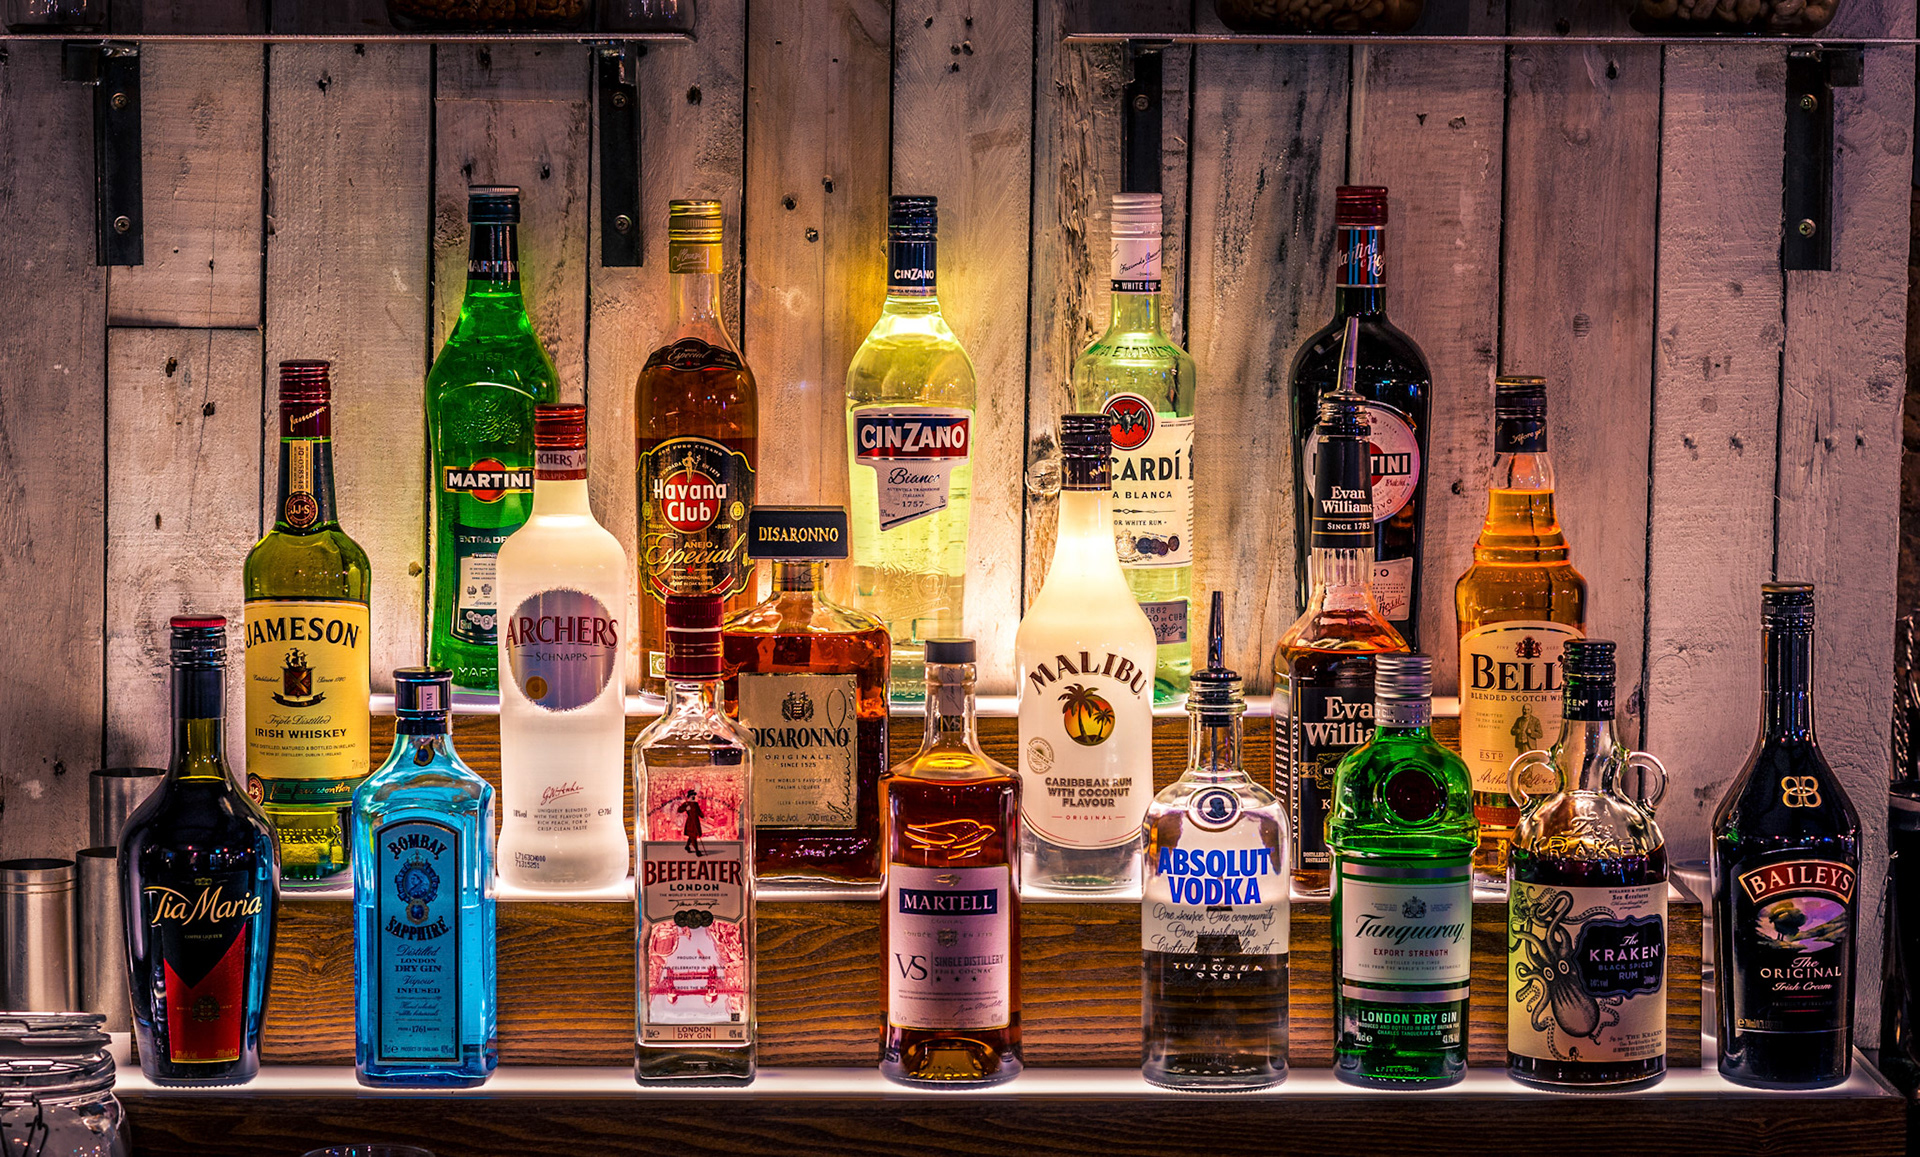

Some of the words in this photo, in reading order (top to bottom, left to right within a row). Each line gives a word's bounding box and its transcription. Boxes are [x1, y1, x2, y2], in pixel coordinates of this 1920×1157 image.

[894, 268, 934, 280] CINZANO
[1122, 282, 1144, 290] WHITE
[860, 422, 965, 452] CINZANO
[538, 453, 572, 468] RCHERS
[1111, 449, 1181, 480] CARDÍ
[1370, 454, 1408, 474] TINI
[448, 472, 531, 488] MARTINI
[888, 468, 940, 484] Bianco
[654, 478, 727, 500] Havana
[1126, 490, 1172, 498] BLANCA
[1331, 486, 1366, 499] Evan
[668, 501, 711, 522] Club
[1321, 499, 1372, 514] Williams
[1327, 522, 1352, 530] SINCE
[1354, 522, 1370, 530] 1783
[460, 535, 492, 544] EXTRA
[493, 535, 509, 544] DR
[758, 526, 839, 544] DISARONNO
[684, 540, 713, 550] AÑEJO
[642, 532, 746, 576] Especial
[1169, 613, 1187, 622] CUBA
[246, 616, 360, 649] JAMESON
[505, 616, 619, 650] ARCHERS
[535, 651, 588, 661] SCHNAPPS
[457, 666, 498, 678] MART
[1028, 651, 1147, 696] MALIBU
[1470, 653, 1563, 692] BELL'
[1471, 692, 1507, 701] BLENDED
[1324, 696, 1375, 720] Eva
[265, 714, 292, 728] Triple
[292, 715, 332, 726] Distilled
[255, 728, 284, 739] IRISH
[289, 728, 348, 739] WHISKEY
[1302, 722, 1375, 747] Willia
[1045, 778, 1109, 787] CARIBBEAN
[1113, 777, 1132, 787] RUM
[1048, 788, 1075, 797] WITH
[1079, 788, 1130, 797] COCONUT
[1062, 798, 1115, 807] FLAVOUR
[1292, 797, 1298, 810] IN
[760, 814, 774, 822] 28%
[807, 814, 820, 822] 700
[387, 834, 448, 860] BOMBAY
[1158, 847, 1271, 878] ABSOLUT
[644, 860, 743, 886] BEEFEATER
[670, 883, 719, 892] LONDON
[1750, 866, 1852, 895] BAILEYS
[1168, 877, 1262, 905] VODKA
[144, 885, 194, 924] Tia
[182, 885, 262, 926] Maria
[904, 894, 993, 911] MARTELL
[1153, 902, 1174, 920] One
[1206, 910, 1230, 924] One
[1231, 905, 1277, 931] community
[385, 915, 451, 941] SAPPHIRE
[1167, 921, 1196, 938] One
[1355, 914, 1464, 945] Tanqueray
[1620, 932, 1639, 946] The
[396, 944, 440, 956] Distilled
[1374, 948, 1404, 957] EXPORT
[1409, 949, 1449, 957] STRENGTH
[1590, 944, 1659, 961] KRAKEN
[894, 953, 927, 980] VS
[935, 956, 962, 967] SINGLE
[964, 954, 1003, 966] DISTILLERY
[1629, 961, 1653, 969] SPICED
[1791, 957, 1820, 968] The
[1619, 971, 1638, 980] RUM
[1760, 966, 1842, 978] ORIGINAL
[402, 975, 434, 988] Vapour
[1772, 982, 1801, 991] Irish
[1802, 982, 1832, 991] Cream
[1361, 1011, 1409, 1024] LONDON
[1415, 1014, 1438, 1024] DRY
[1442, 1011, 1457, 1023] GIN
